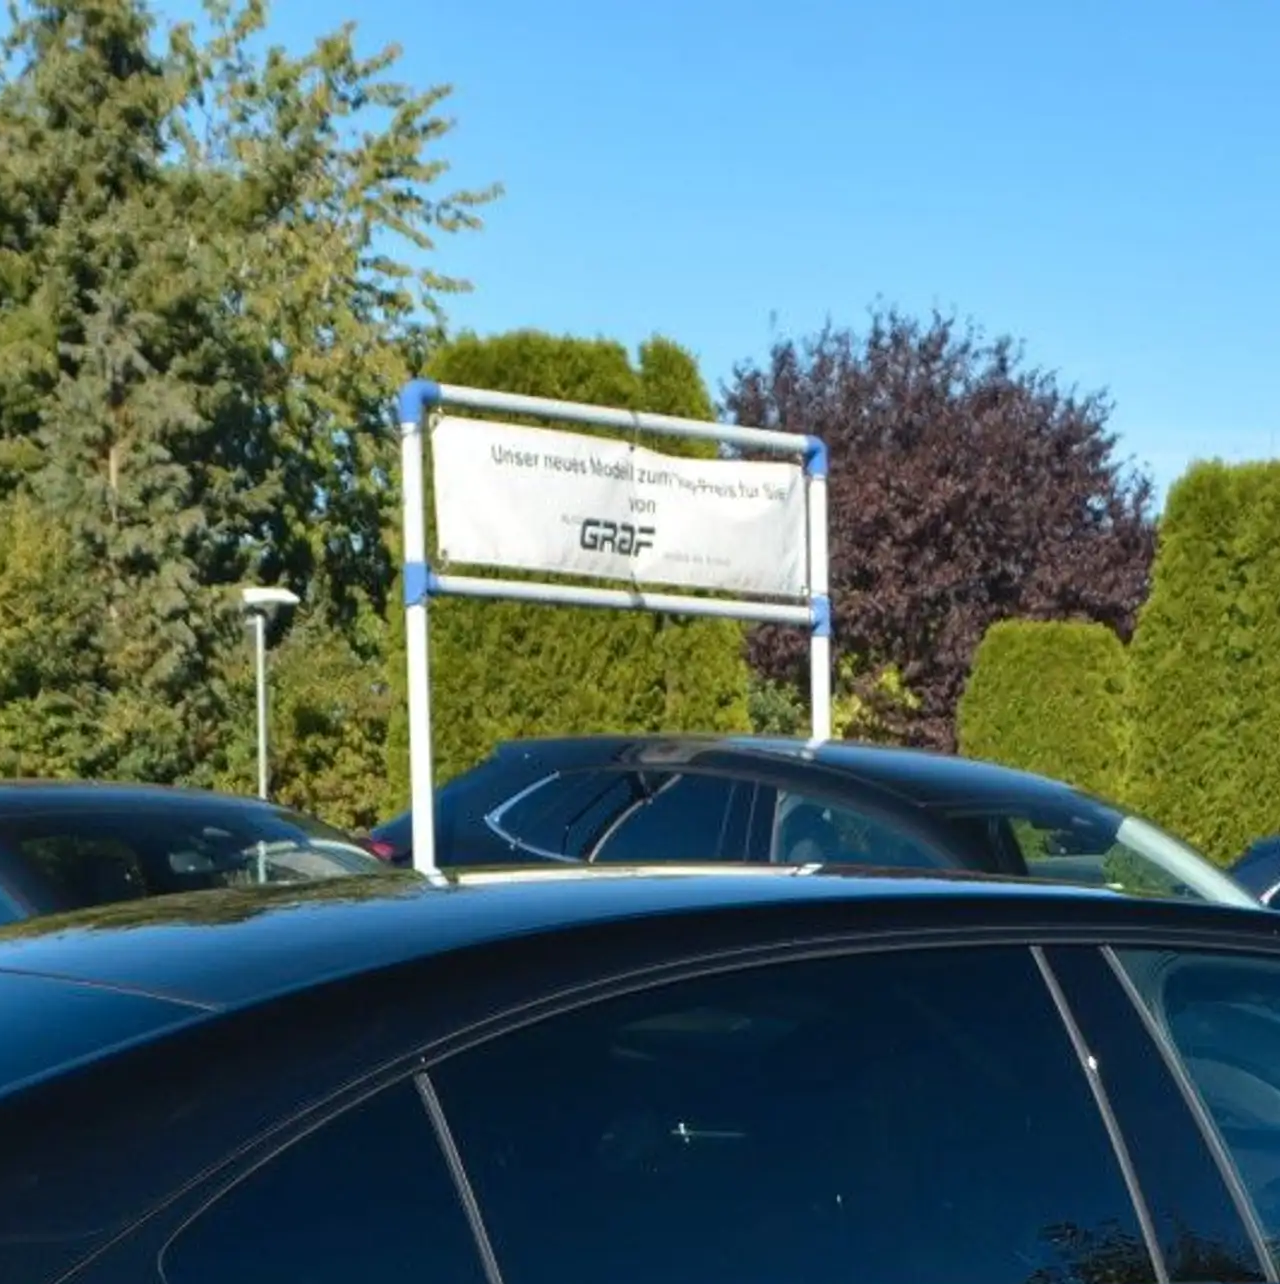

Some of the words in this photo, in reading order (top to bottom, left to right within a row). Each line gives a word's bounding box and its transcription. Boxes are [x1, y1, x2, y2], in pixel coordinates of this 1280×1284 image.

[491, 444, 540, 467] Unser
[544, 454, 587, 475] neues
[589, 456, 634, 481] Modell
[637, 468, 668, 485] zum
